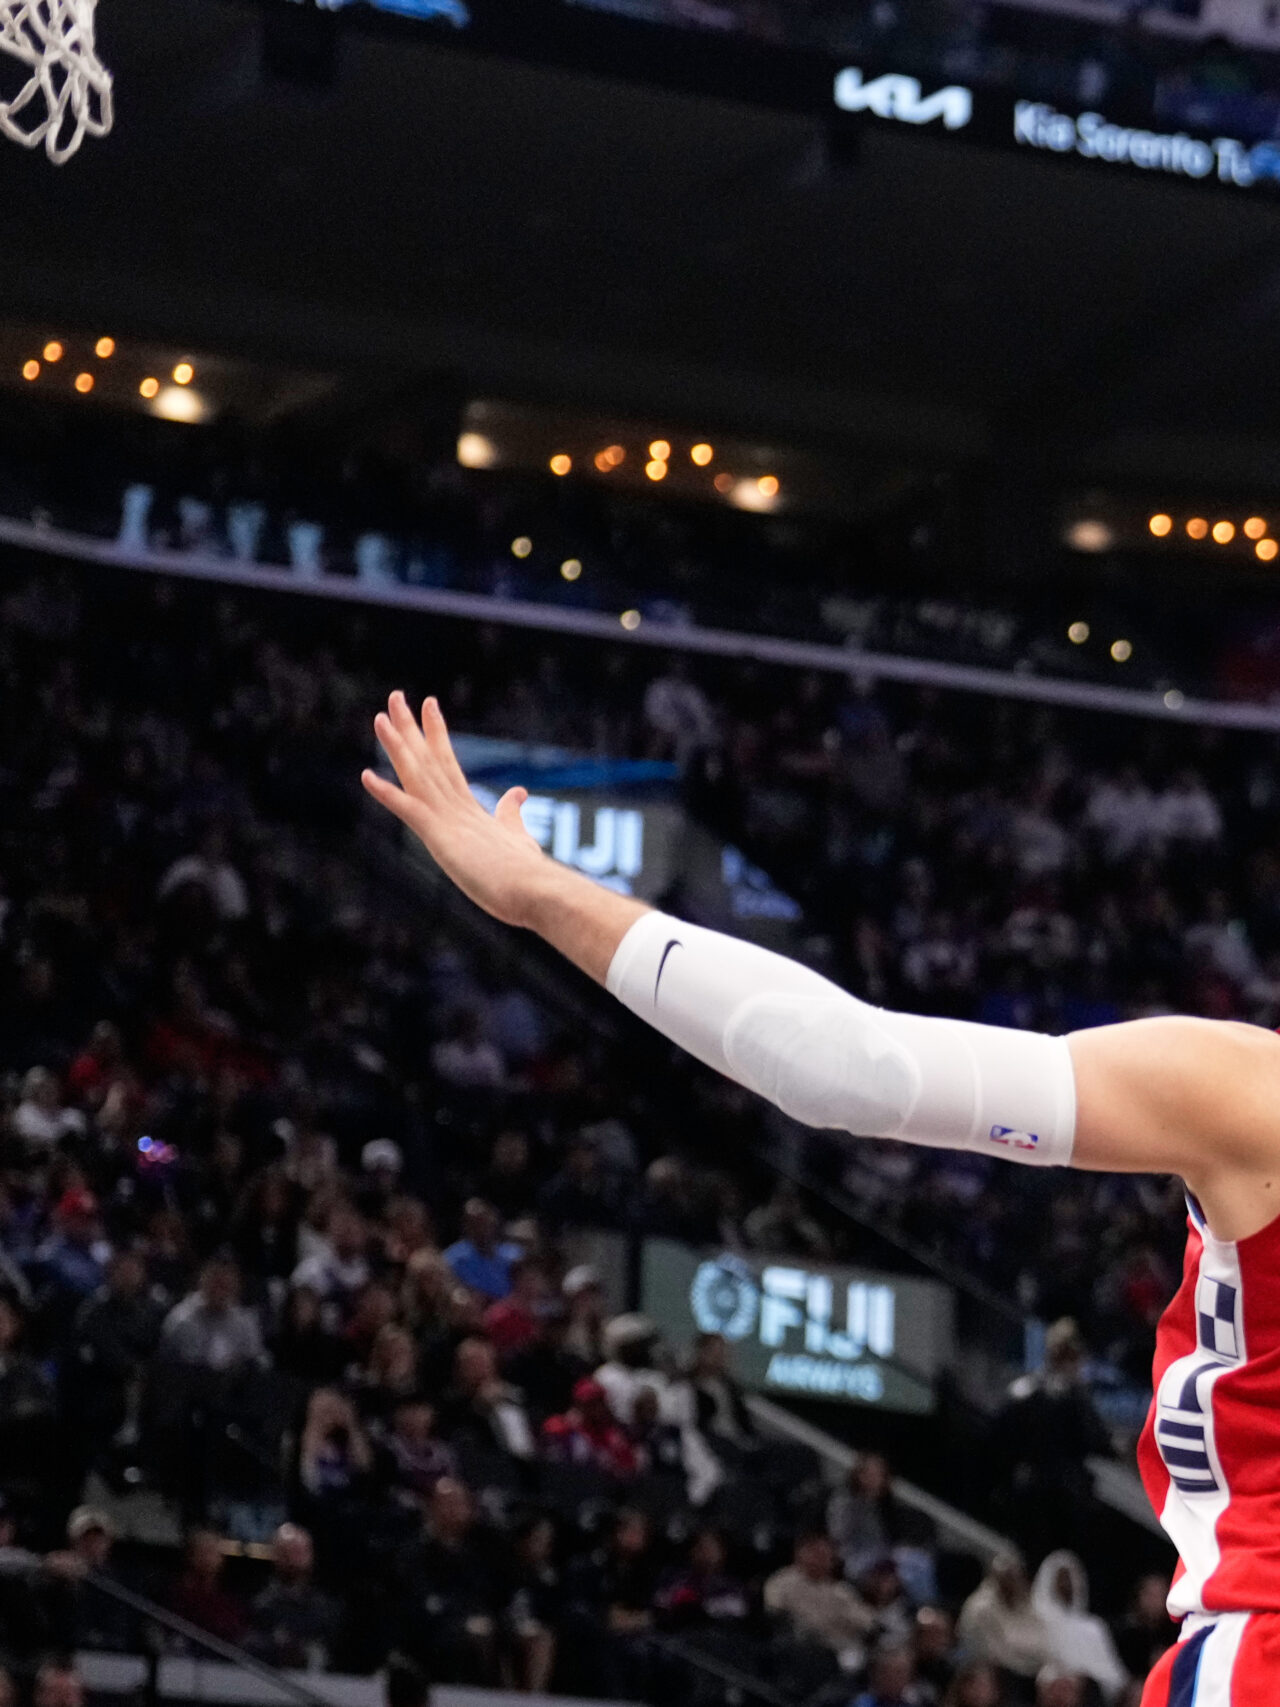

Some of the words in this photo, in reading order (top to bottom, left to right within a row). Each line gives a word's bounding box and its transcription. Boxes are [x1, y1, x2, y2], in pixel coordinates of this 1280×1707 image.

[1014, 99, 1076, 152] Kia
[1077, 112, 1214, 178] Sorento
[760, 1266, 895, 1359] FIJI
